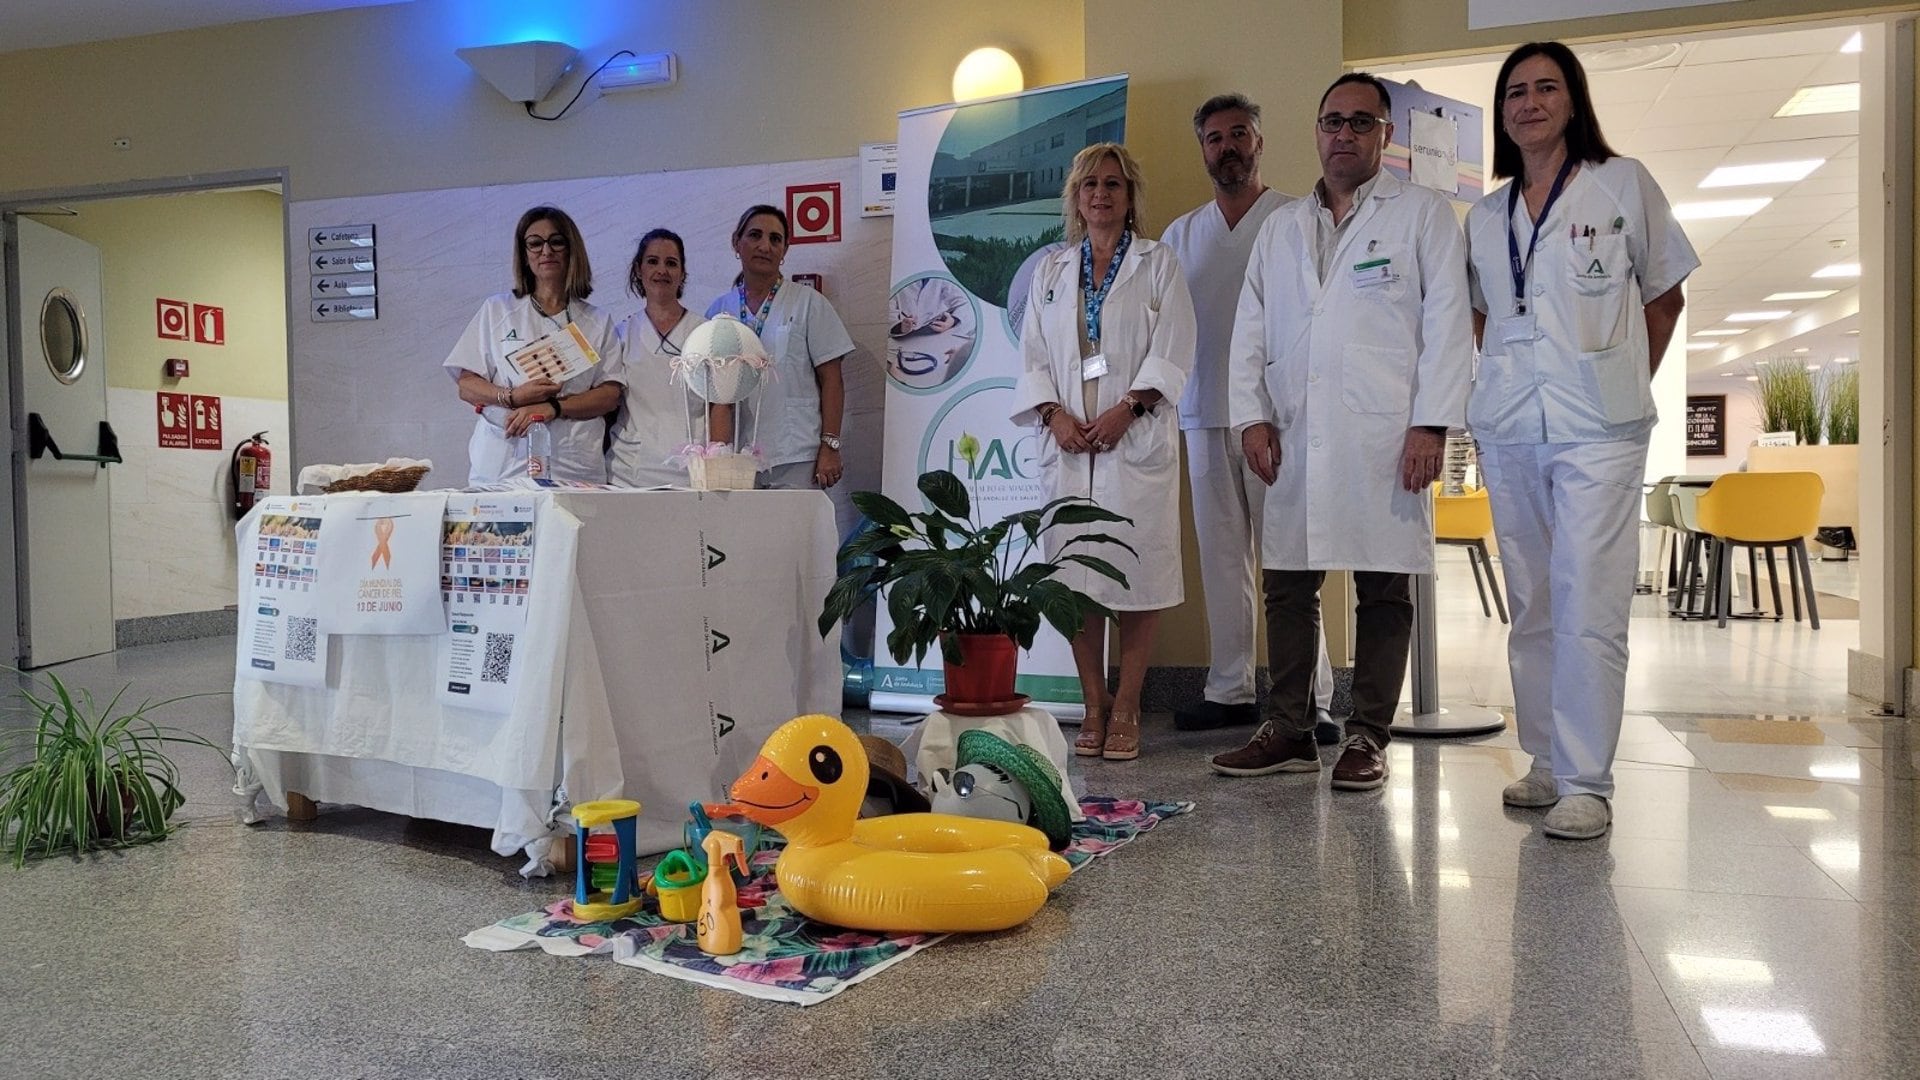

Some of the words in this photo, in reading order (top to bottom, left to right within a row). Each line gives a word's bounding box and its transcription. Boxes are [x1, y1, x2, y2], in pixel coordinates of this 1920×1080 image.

[357, 601, 366, 612] 13
[366, 601, 377, 612] DE
[378, 600, 403, 612] JUNIO
